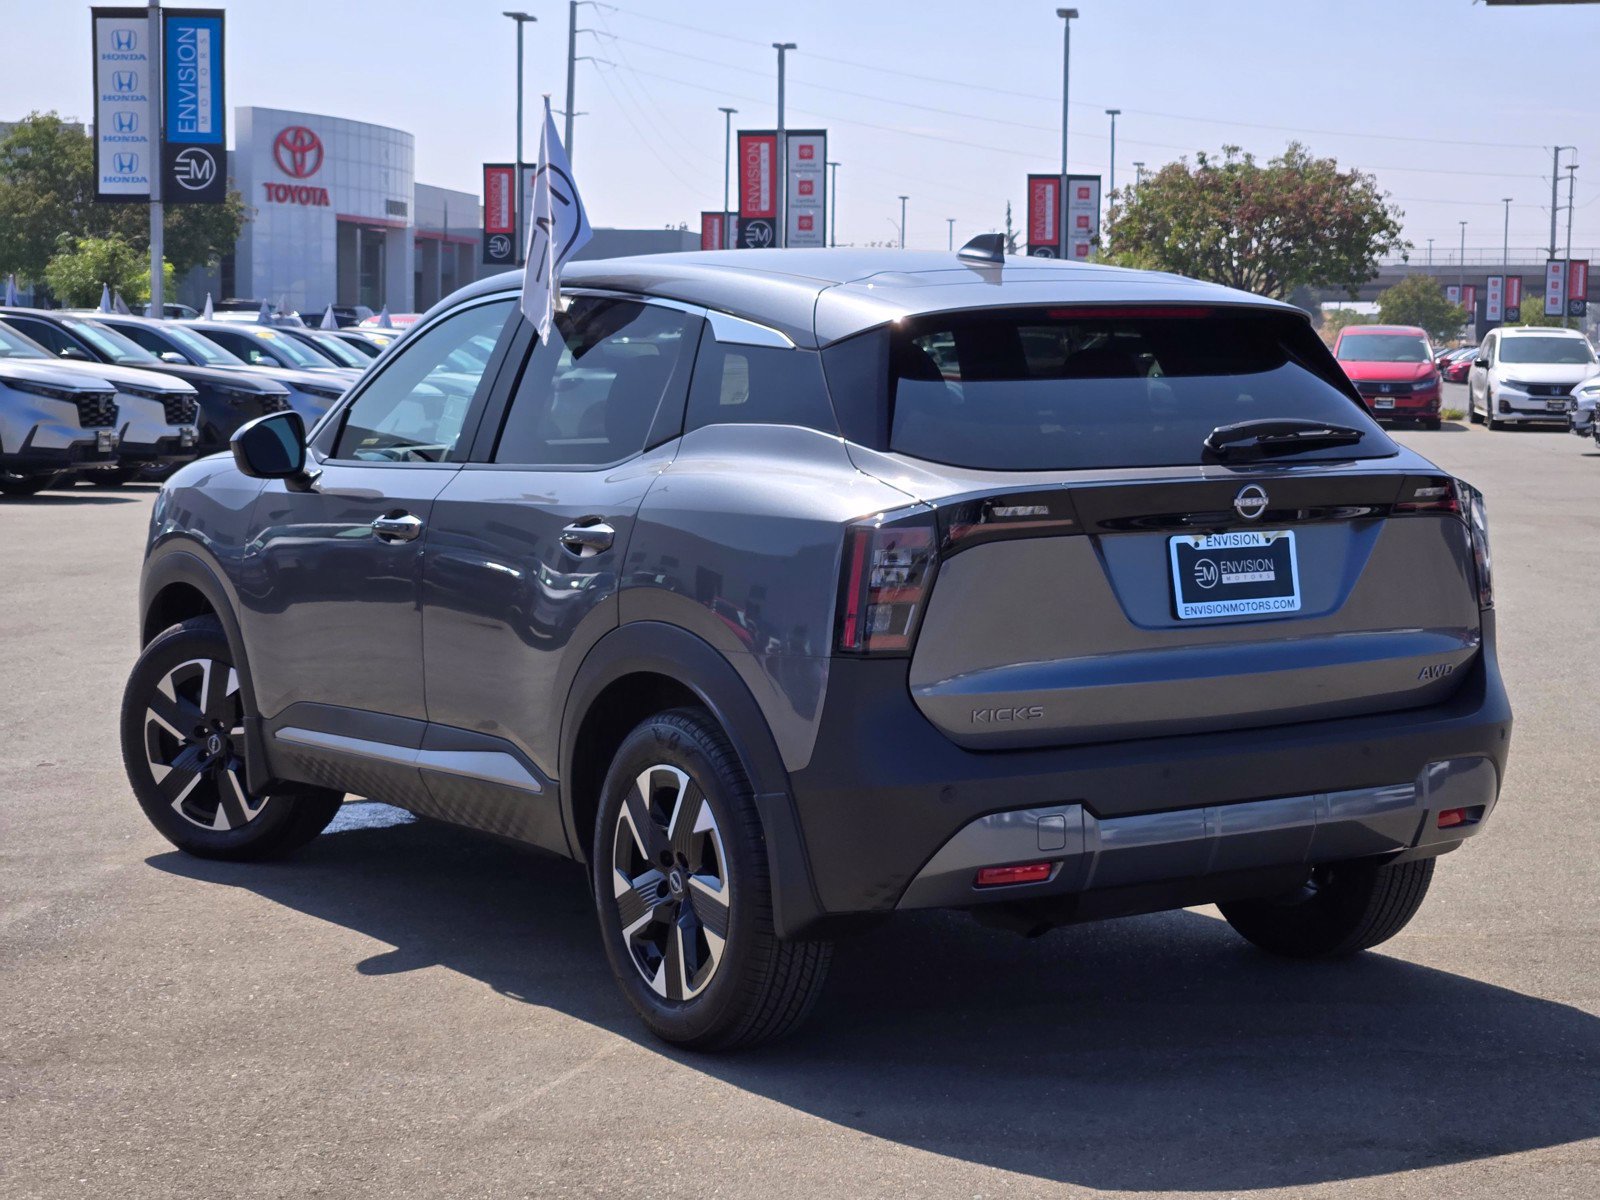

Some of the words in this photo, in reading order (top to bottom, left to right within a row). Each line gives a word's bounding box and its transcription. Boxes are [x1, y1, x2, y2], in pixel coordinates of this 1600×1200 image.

[102, 53, 147, 61] HONDA
[177, 27, 197, 133] ENVISION
[102, 94, 148, 102] HONDA
[103, 135, 148, 143] HONDA
[103, 175, 148, 184] HONDA
[747, 142, 760, 212] ENVISION
[262, 182, 330, 207] TOYOTA
[1233, 497, 1269, 507] NISSAN
[1206, 533, 1260, 547] ENVISION
[1220, 558, 1274, 574] ENVISION
[1225, 573, 1271, 581] MOTORS
[1184, 599, 1295, 616] ENVISIONMOTORS.COM
[1417, 663, 1454, 680] AWD
[970, 705, 1044, 724] KICKS
